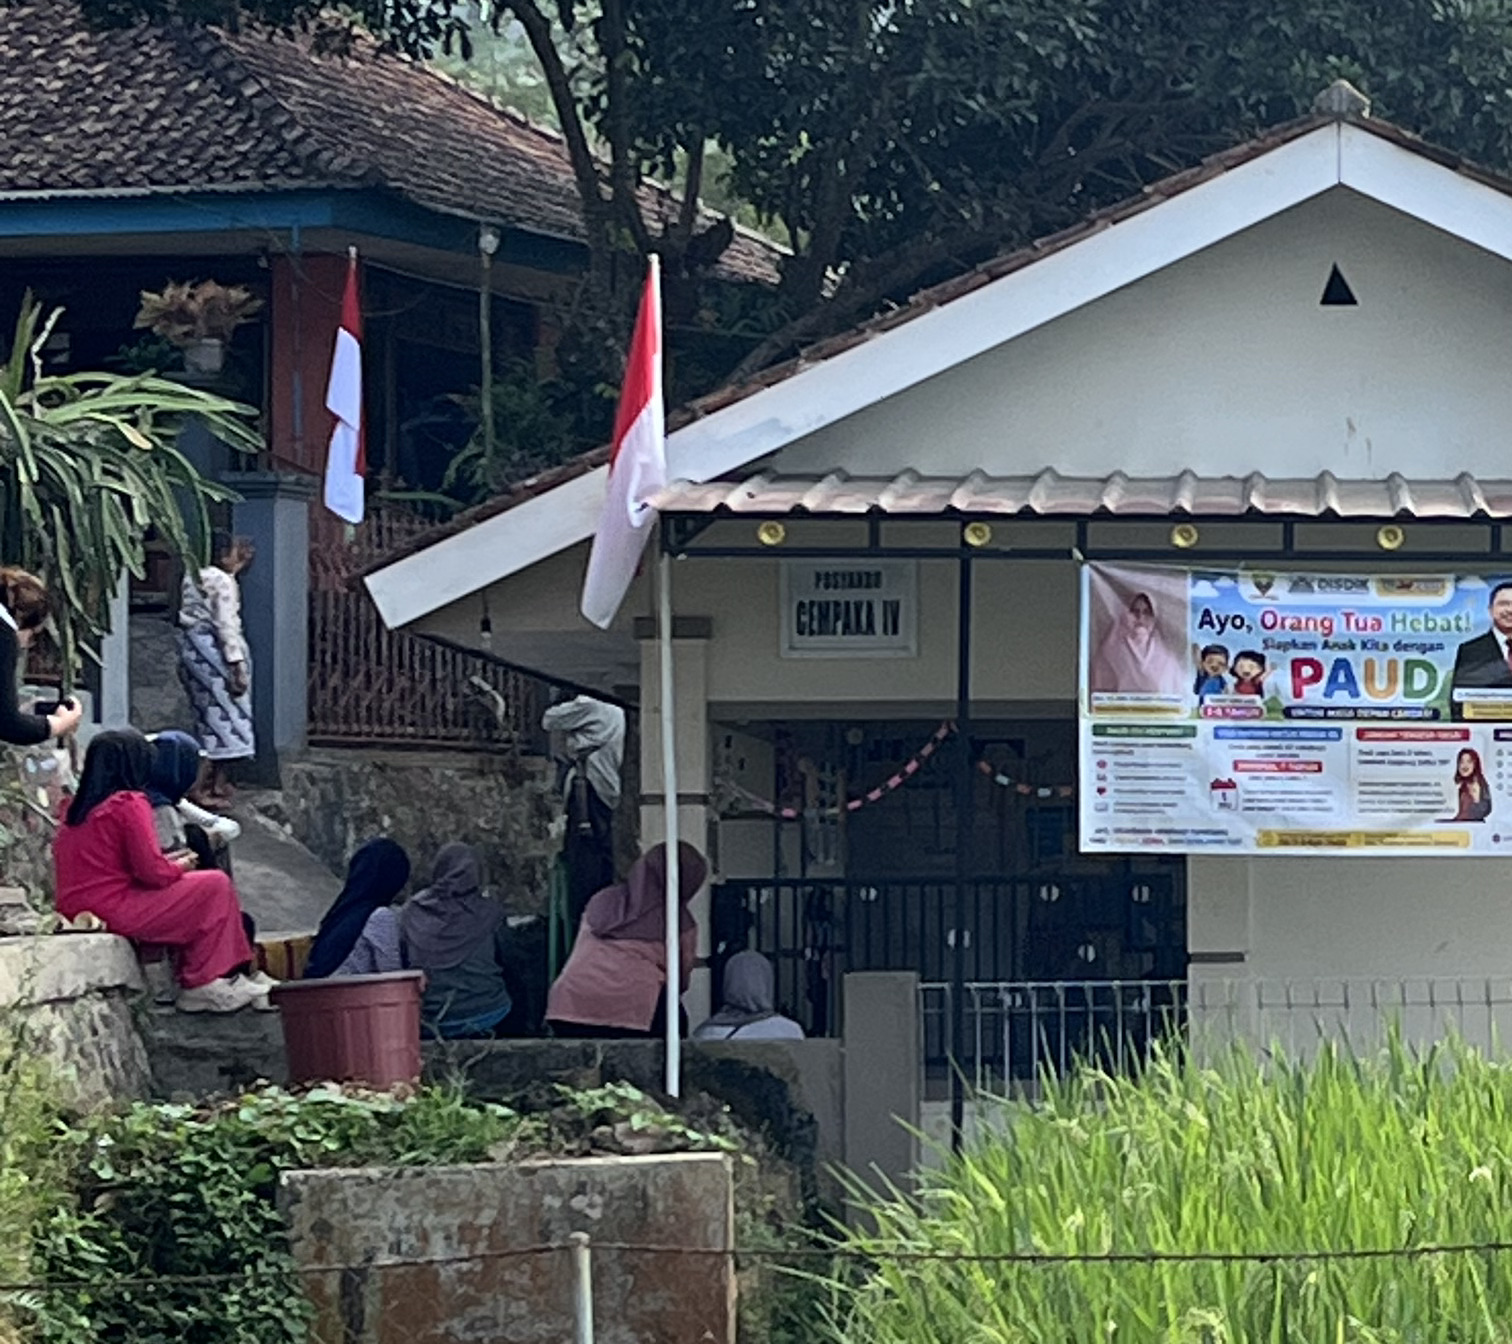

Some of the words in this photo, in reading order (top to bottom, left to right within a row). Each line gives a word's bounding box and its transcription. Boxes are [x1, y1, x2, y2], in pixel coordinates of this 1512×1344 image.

[796, 599, 876, 636] CEMPAKA
[882, 599, 900, 636] IV
[1198, 608, 1253, 636] Ayo,
[1260, 610, 1334, 637] Orang
[1341, 612, 1382, 632] Tua
[1391, 612, 1472, 633] Hebat!
[1291, 657, 1438, 700] PAUD
